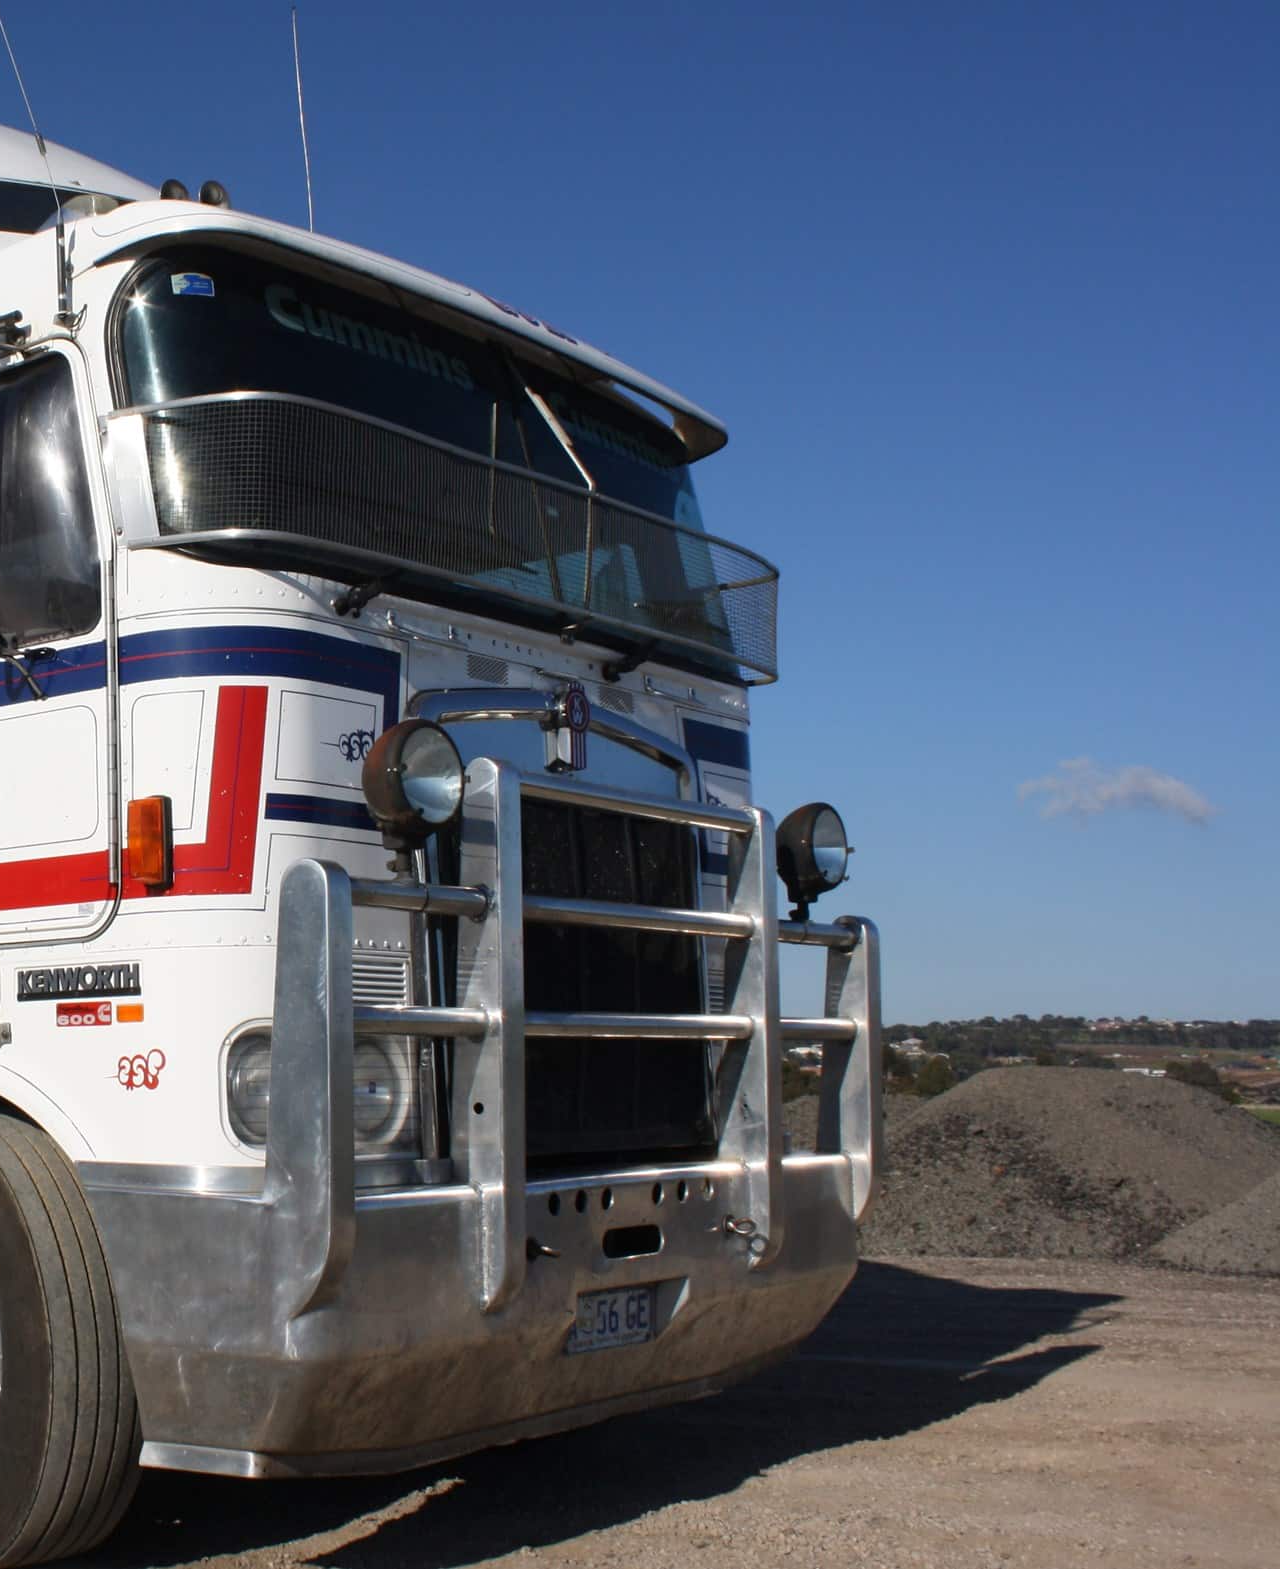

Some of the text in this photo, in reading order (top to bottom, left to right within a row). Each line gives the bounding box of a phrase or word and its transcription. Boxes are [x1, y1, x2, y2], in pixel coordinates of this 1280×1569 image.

[264, 283, 479, 391] Cummins
[18, 964, 140, 993] KENWORTH
[57, 1014, 96, 1026] 600
[598, 1299, 618, 1334] 56
